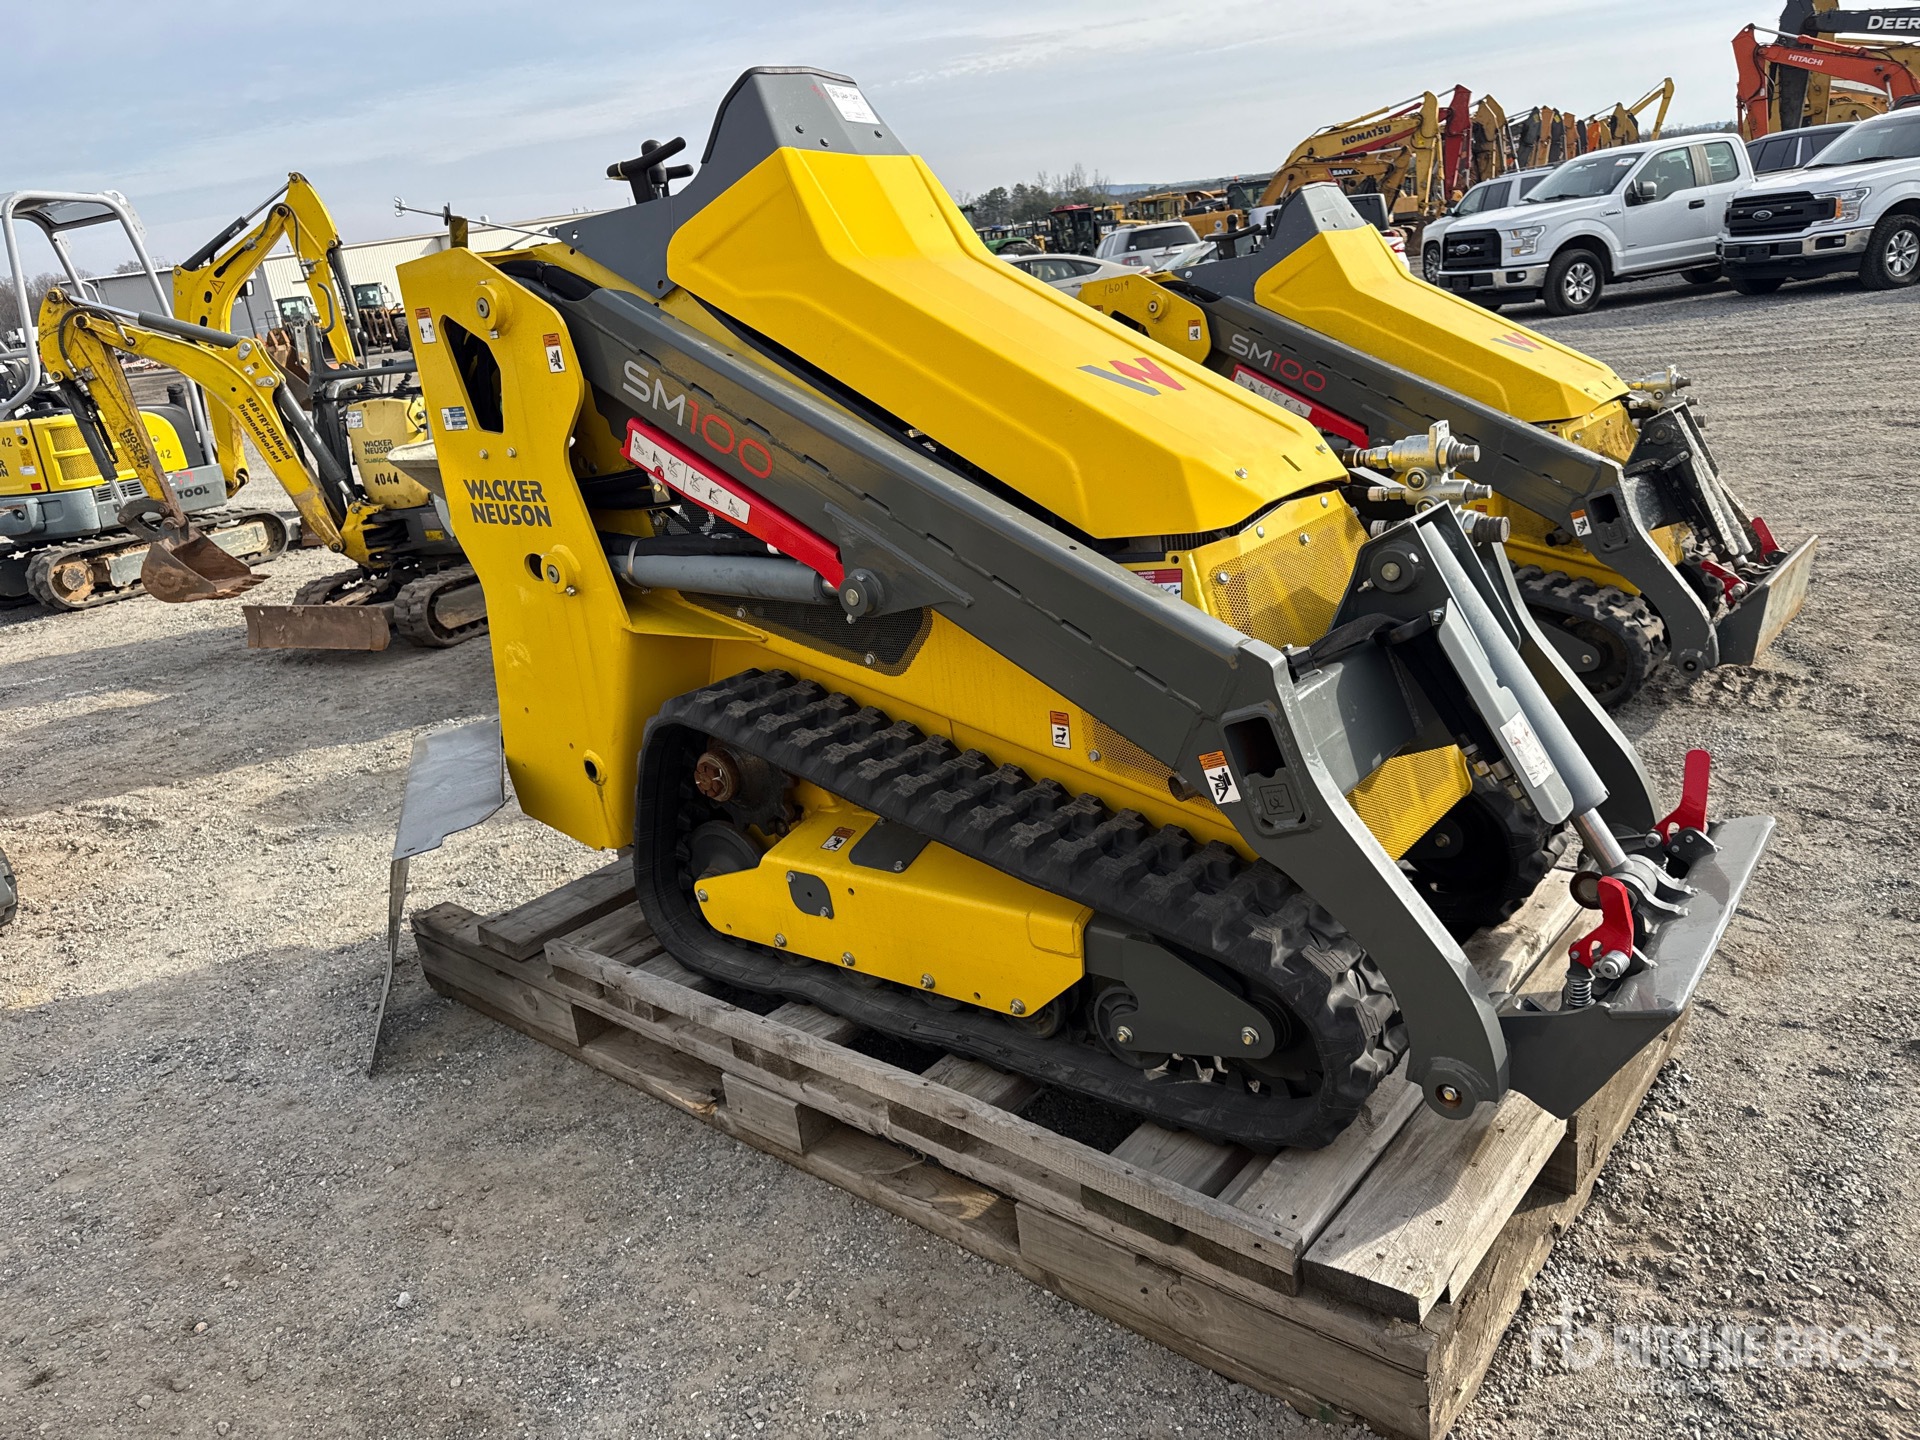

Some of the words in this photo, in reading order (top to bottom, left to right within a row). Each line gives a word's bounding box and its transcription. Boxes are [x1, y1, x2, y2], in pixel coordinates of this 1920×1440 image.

[1788, 53, 1824, 66] HITACHI
[1342, 125, 1391, 145] KOMATSU
[1229, 333, 1326, 392] SM100
[622, 360, 773, 479] SM100
[363, 439, 394, 448] WACKER
[364, 446, 395, 455] NEUSON
[374, 472, 400, 486] 4044
[177, 485, 210, 499] TOOL
[463, 479, 547, 502] WACKER
[470, 503, 552, 527] NEUSON
